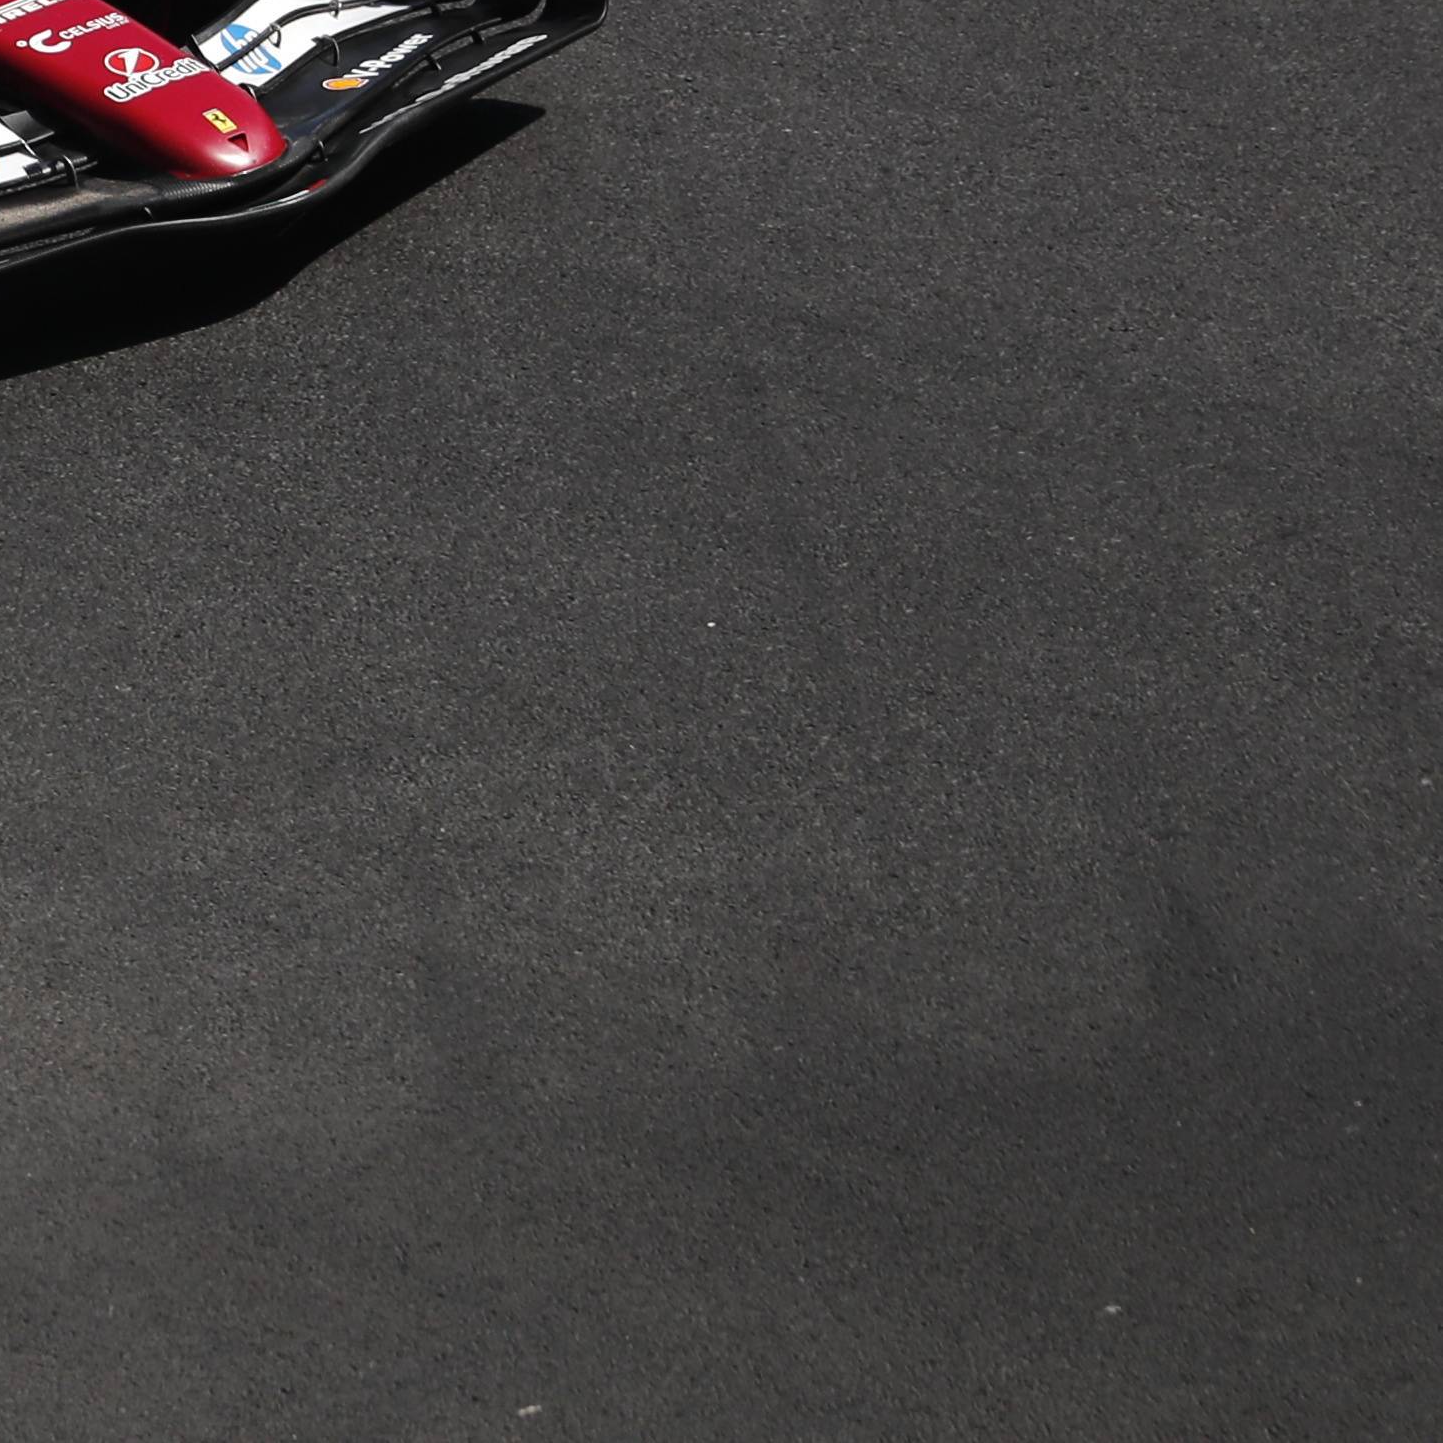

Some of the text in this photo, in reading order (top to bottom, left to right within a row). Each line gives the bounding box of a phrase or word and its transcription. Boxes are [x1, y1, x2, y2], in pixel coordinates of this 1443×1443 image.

[59, 12, 125, 40] CELSIUS
[103, 57, 211, 103] UniCredit
[341, 33, 434, 81] V-Power
